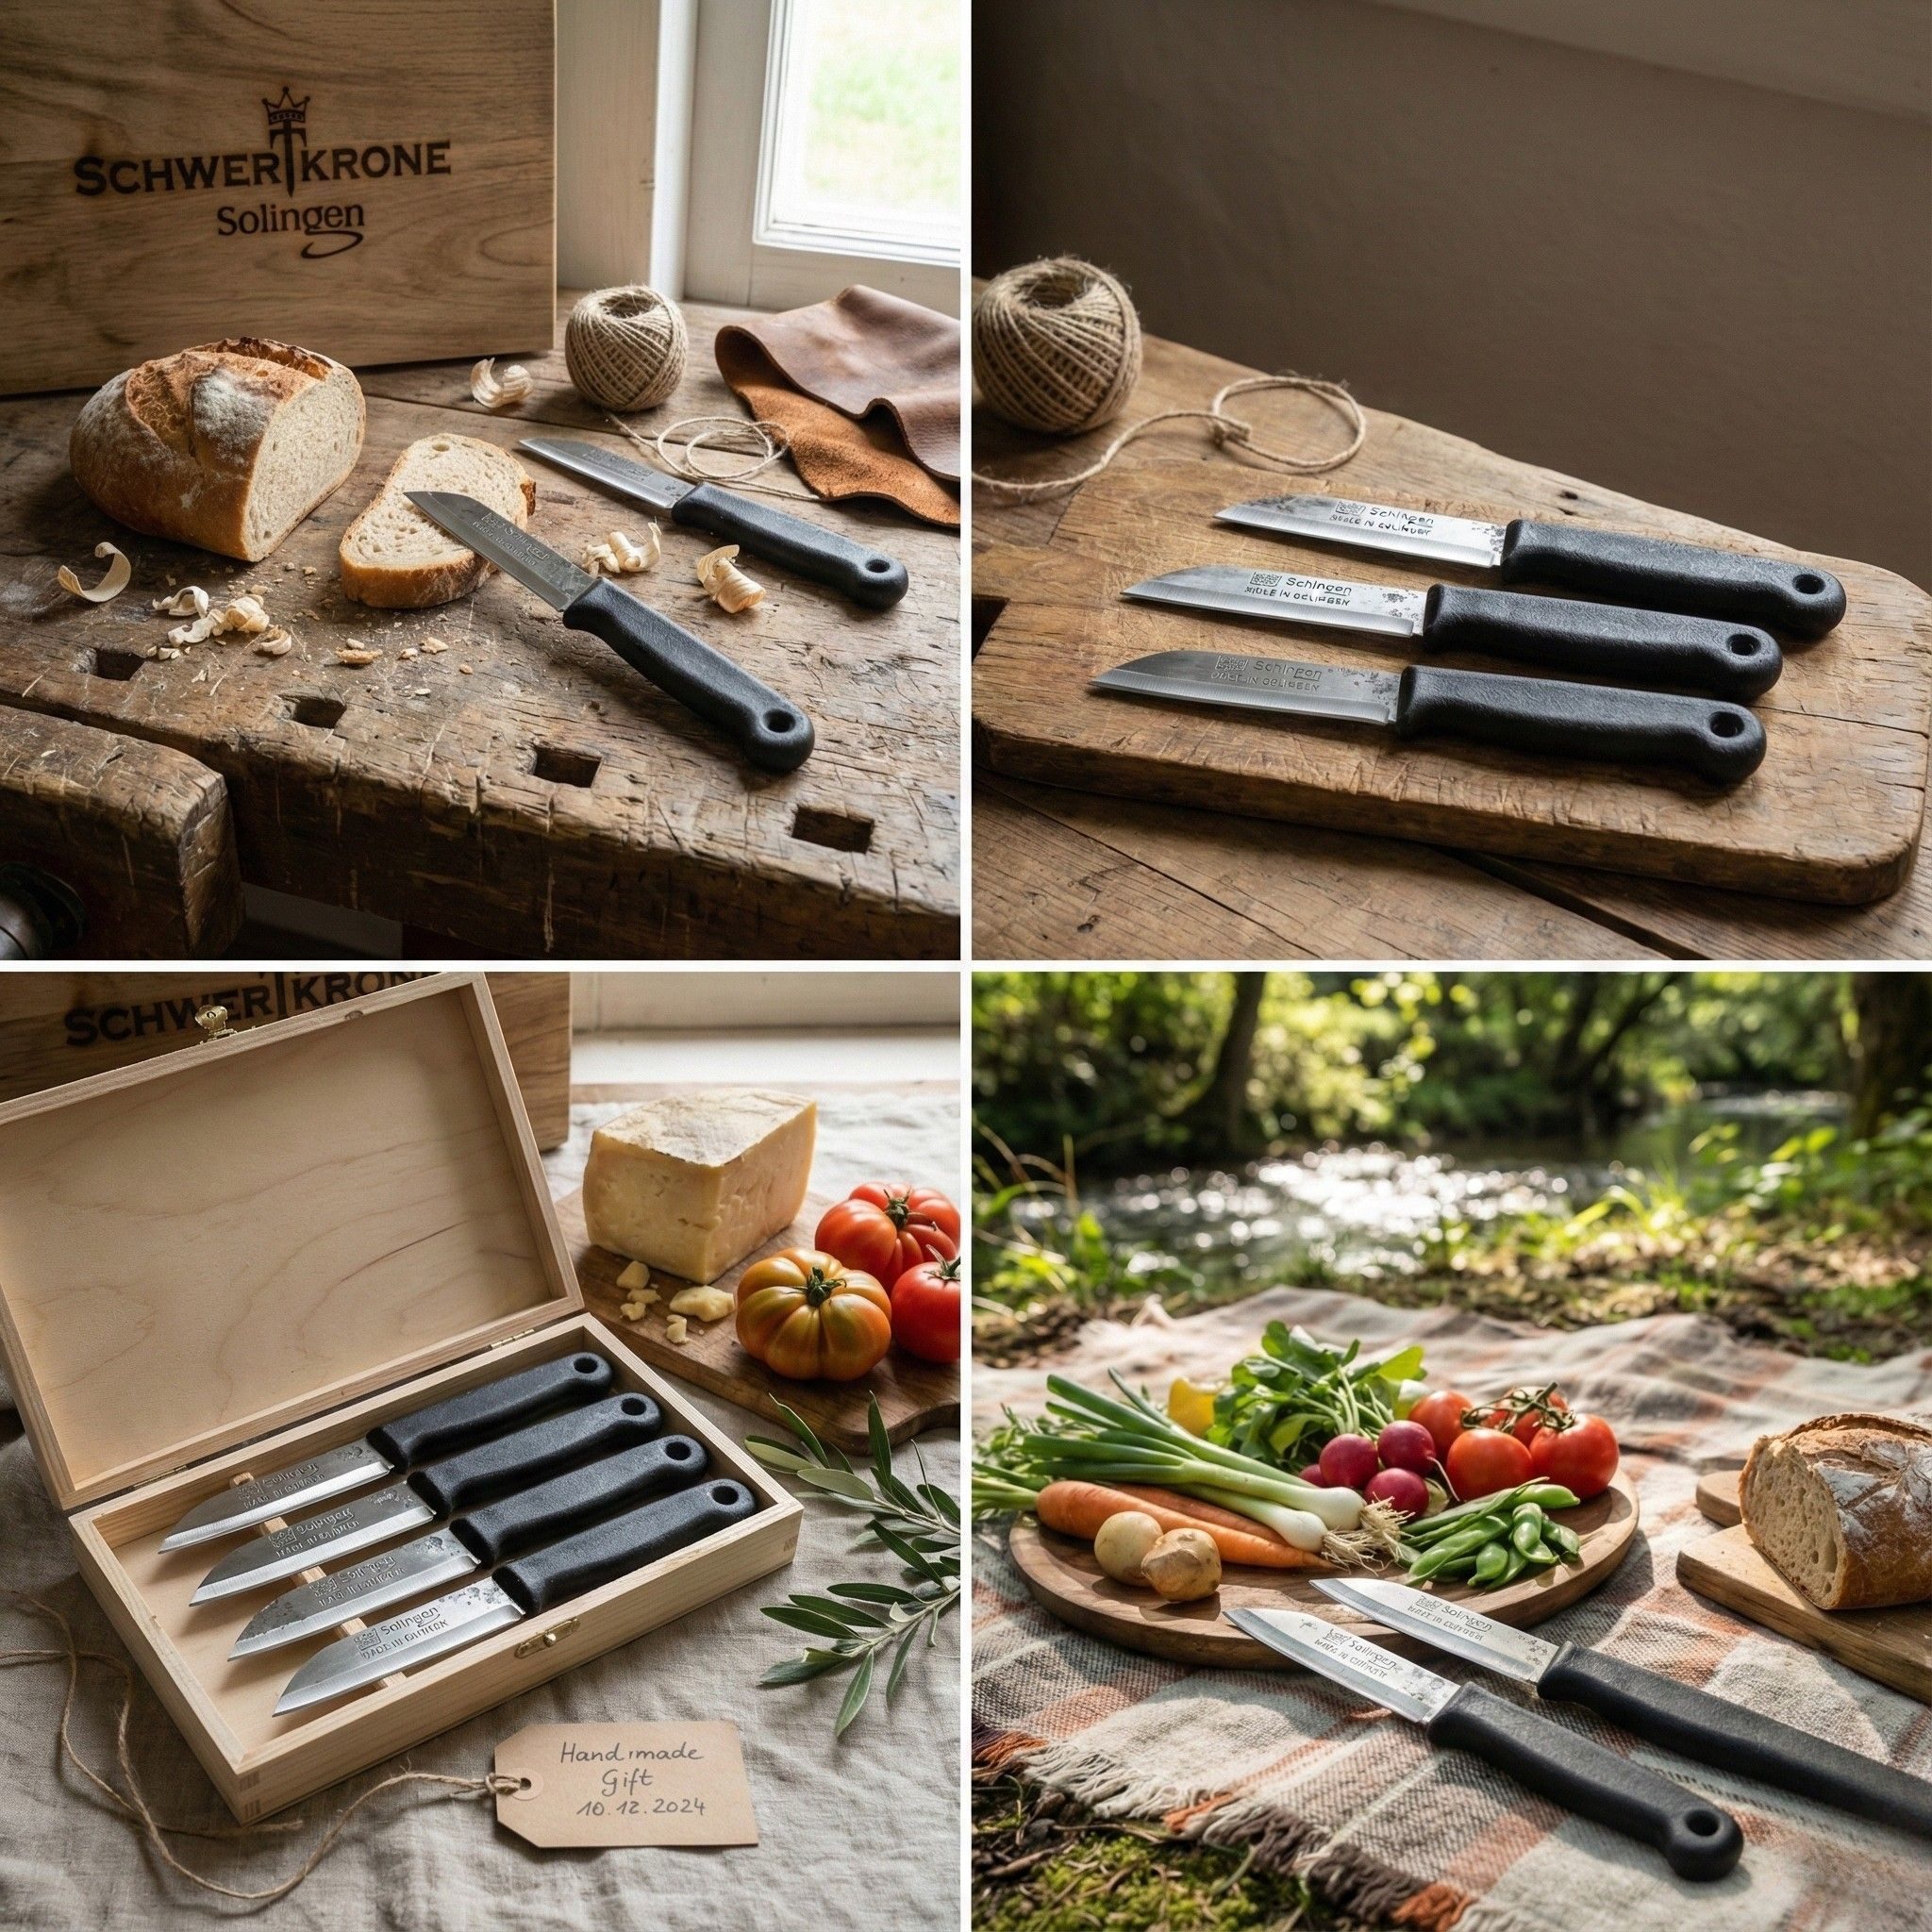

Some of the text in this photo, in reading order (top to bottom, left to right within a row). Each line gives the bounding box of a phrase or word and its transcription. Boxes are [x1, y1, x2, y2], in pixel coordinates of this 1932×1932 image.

[217, 202, 366, 259] Solingen
[601, 1767, 654, 1797] Gift
[575, 1797, 706, 1817] 10.12.2024
